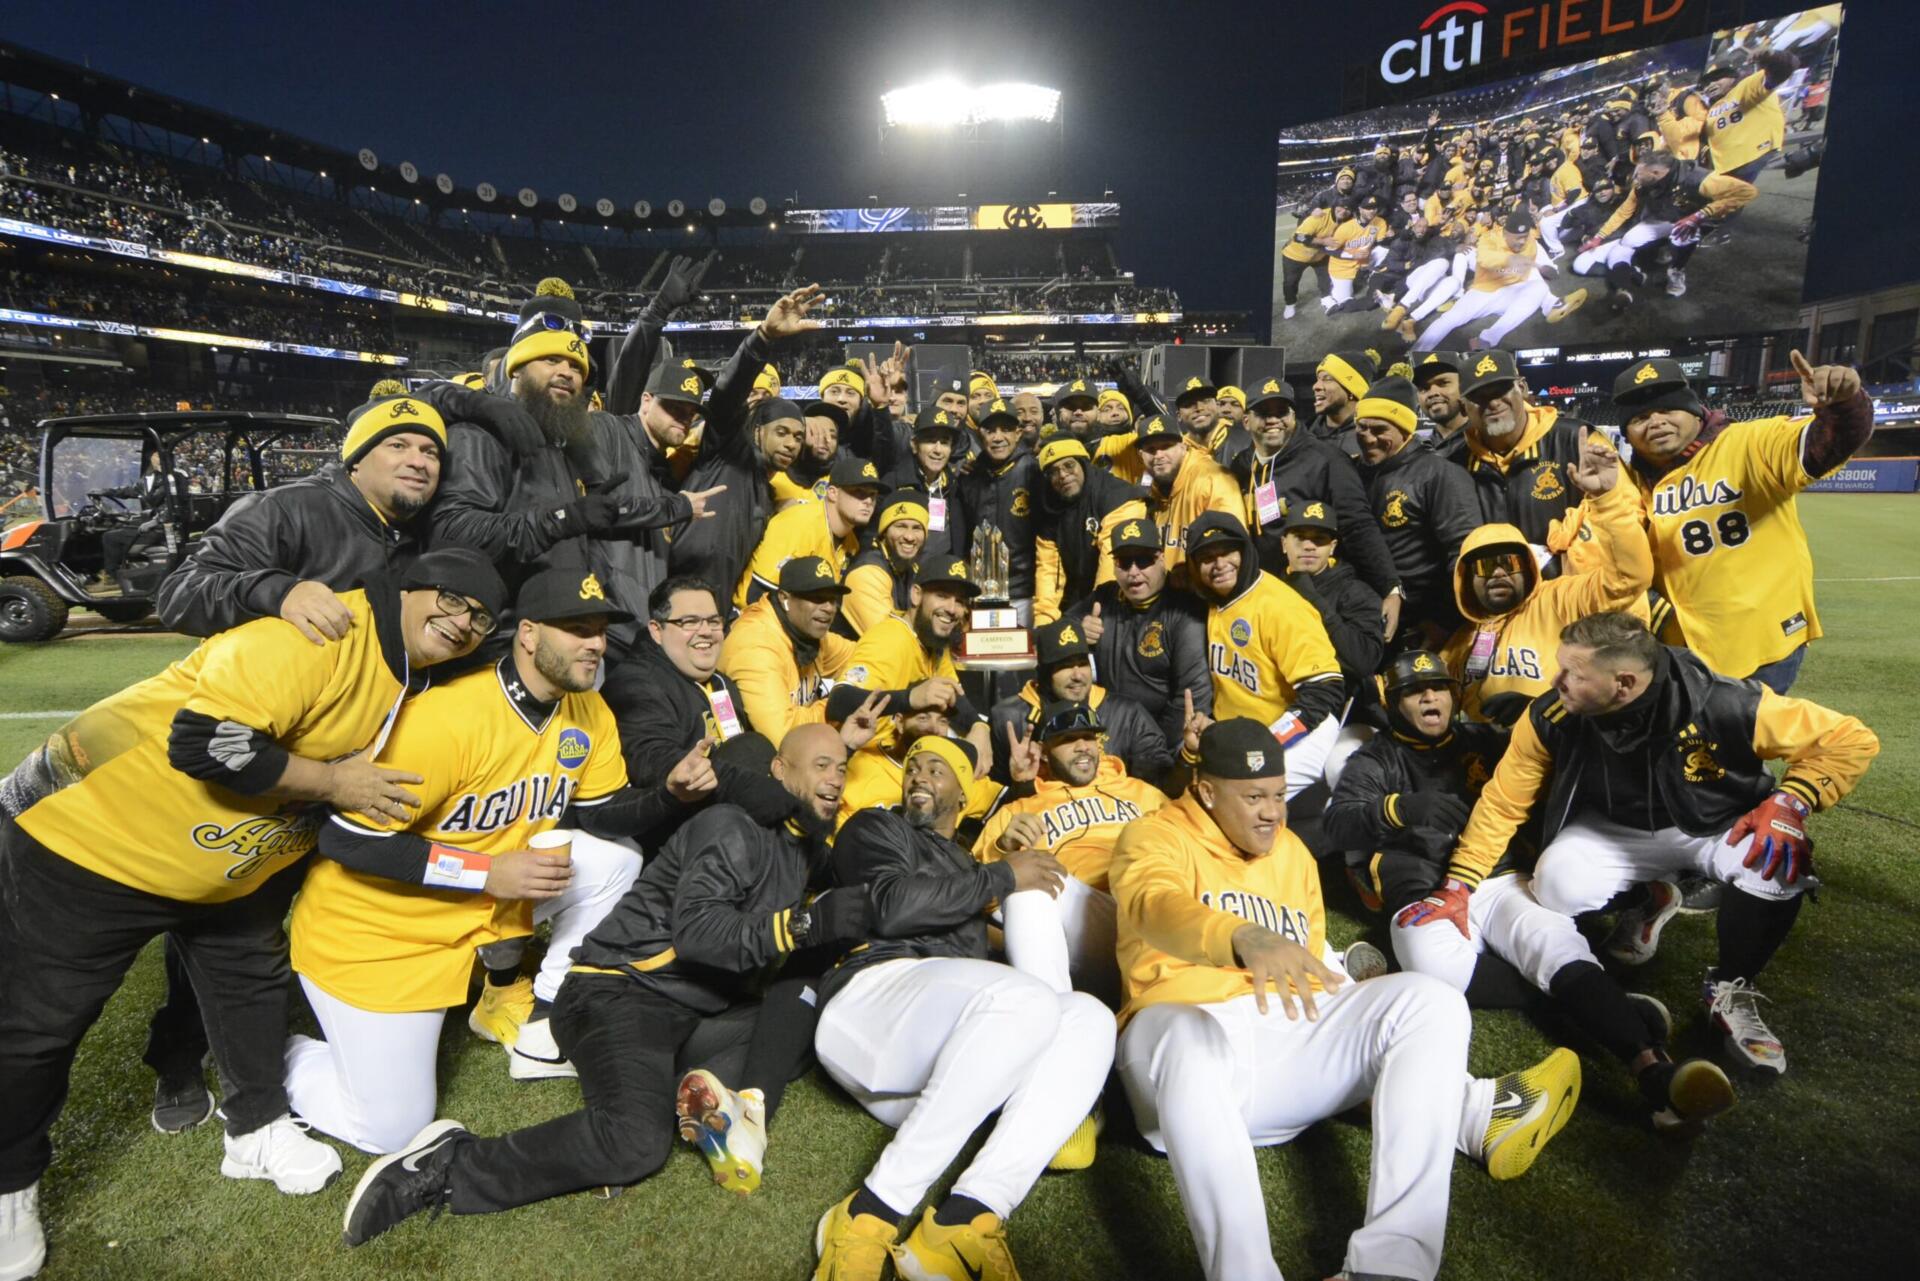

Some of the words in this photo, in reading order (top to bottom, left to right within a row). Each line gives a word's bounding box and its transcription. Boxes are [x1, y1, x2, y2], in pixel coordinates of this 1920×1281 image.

[1380, 15, 1484, 84] citi
[1681, 510, 1751, 556] 88
[1209, 643, 1258, 693] ILAS
